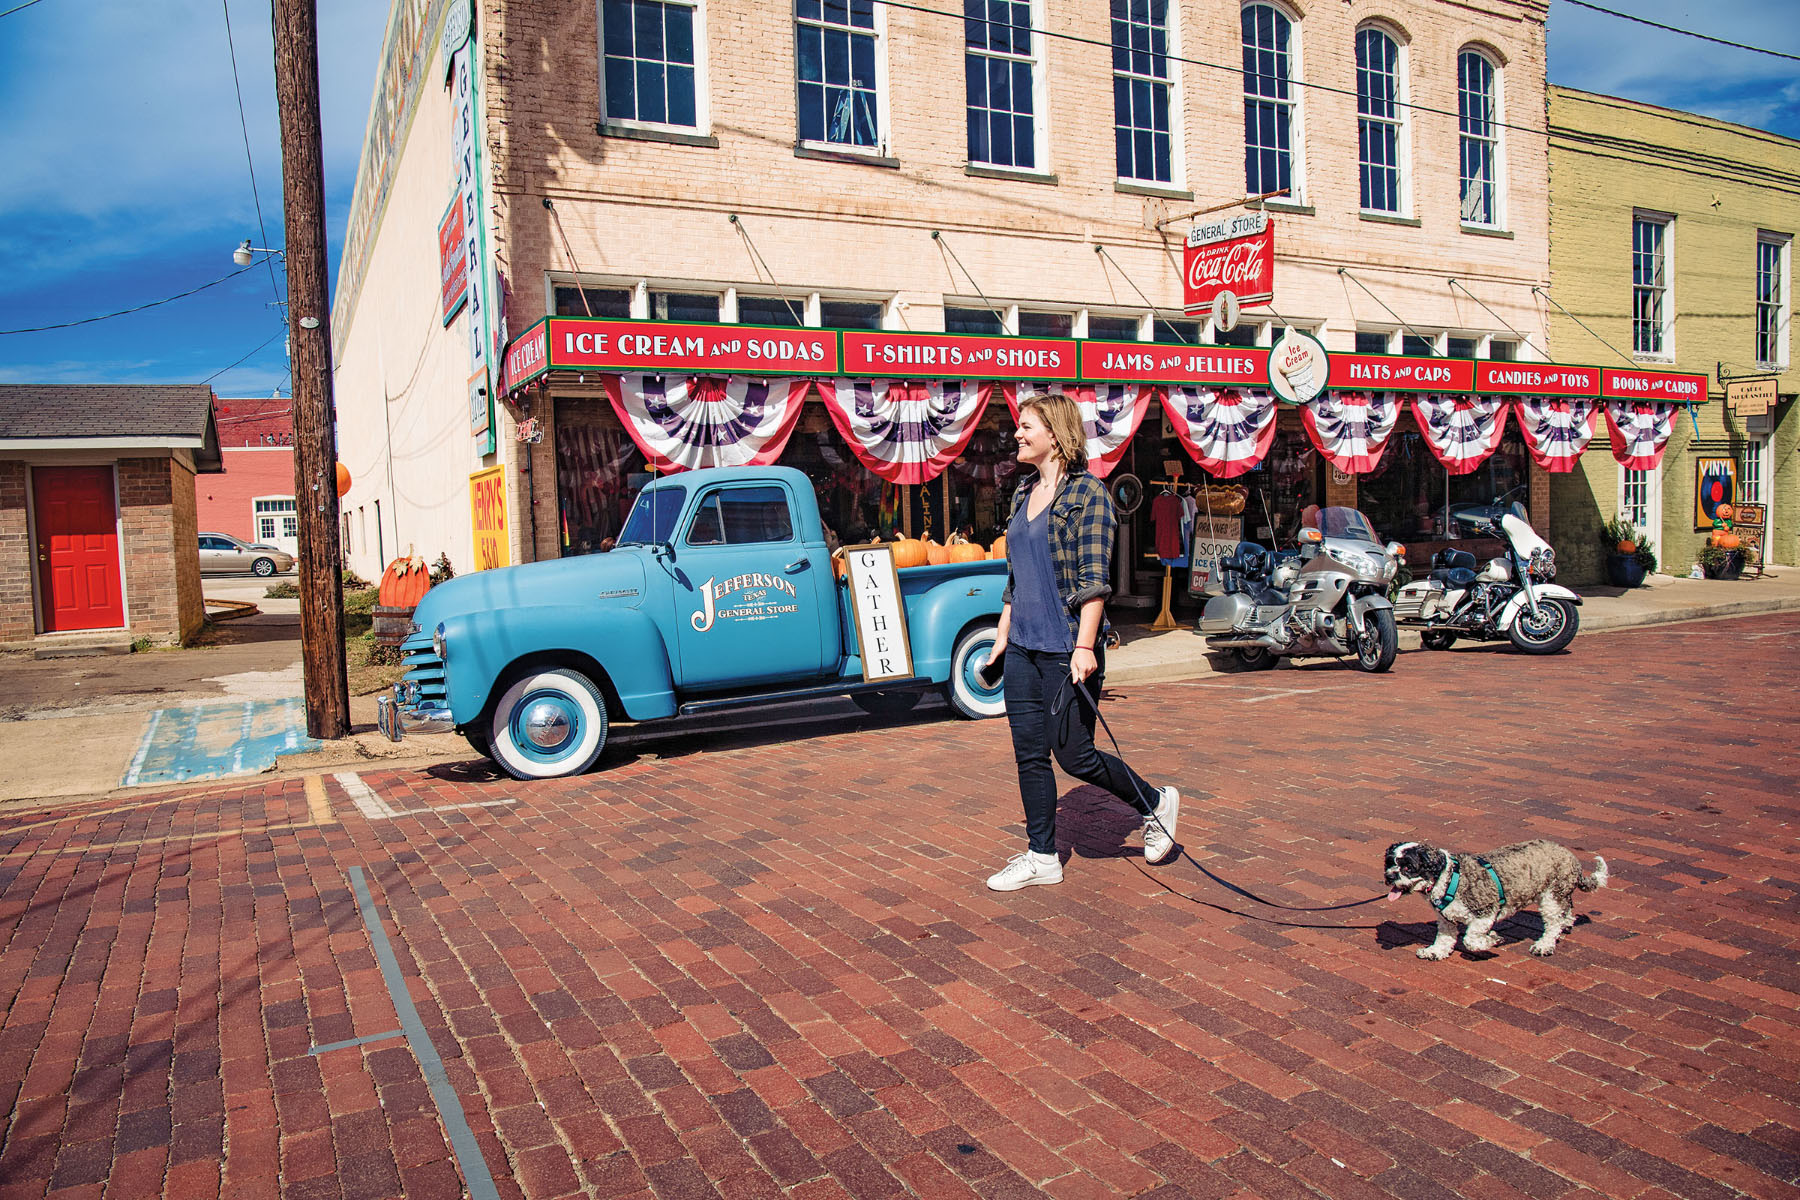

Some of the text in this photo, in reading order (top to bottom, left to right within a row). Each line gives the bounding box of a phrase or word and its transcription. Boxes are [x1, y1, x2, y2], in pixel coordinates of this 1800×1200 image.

[460, 62, 482, 359] GENERAL
[1191, 215, 1262, 243] GENERAL STORE
[1206, 246, 1230, 257] DRINK
[510, 331, 545, 377] ICE CREAM
[565, 332, 825, 361] ICE CREAM AND SODAS
[862, 343, 1061, 368] T-SHIRTS AND SHOES
[1288, 344, 1301, 356] Ice
[1102, 352, 1255, 375] JAMS AND JELLIES
[1285, 350, 1309, 368] Cream
[1349, 363, 1452, 383] HATS AND CAPS
[1488, 369, 1590, 388] CANDIES AND TOYS
[1612, 376, 1698, 395] BOOKS AND CARDS
[1699, 459, 1734, 477] VINYL
[473, 476, 504, 531] HENRYS
[1195, 558, 1208, 568] ICE
[691, 572, 797, 633] JEFFERSON
[742, 589, 767, 602] TEXAS
[718, 604, 798, 619] GENERAL STORE
[861, 552, 894, 674] GATHER
